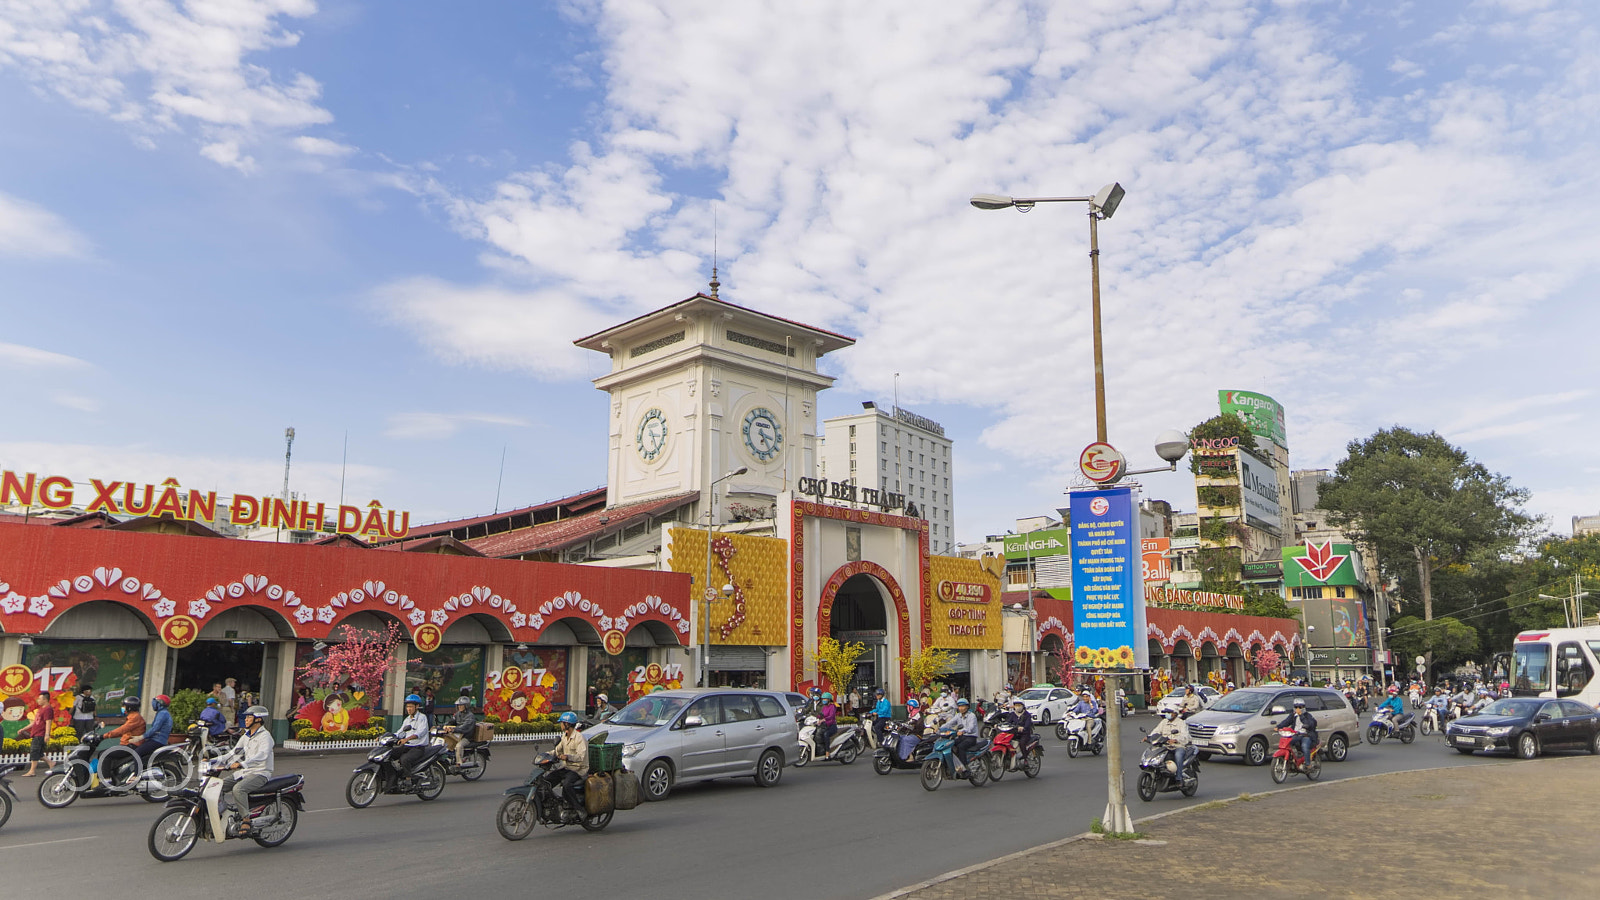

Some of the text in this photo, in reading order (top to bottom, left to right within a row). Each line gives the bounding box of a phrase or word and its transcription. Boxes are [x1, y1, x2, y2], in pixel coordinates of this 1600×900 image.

[798, 476, 906, 509] CHỢ BẾN THÀNH
[1, 470, 410, 543] NG XUÂN ĐINH DẬU
[1142, 559, 1170, 580] Balli
[1166, 583, 1193, 604] ĐẢNG
[1193, 590, 1224, 608] QUANG
[1224, 593, 1244, 610] VINH
[948, 606, 986, 620] GÓP TÌNH
[948, 623, 987, 636] TRAO TẾT
